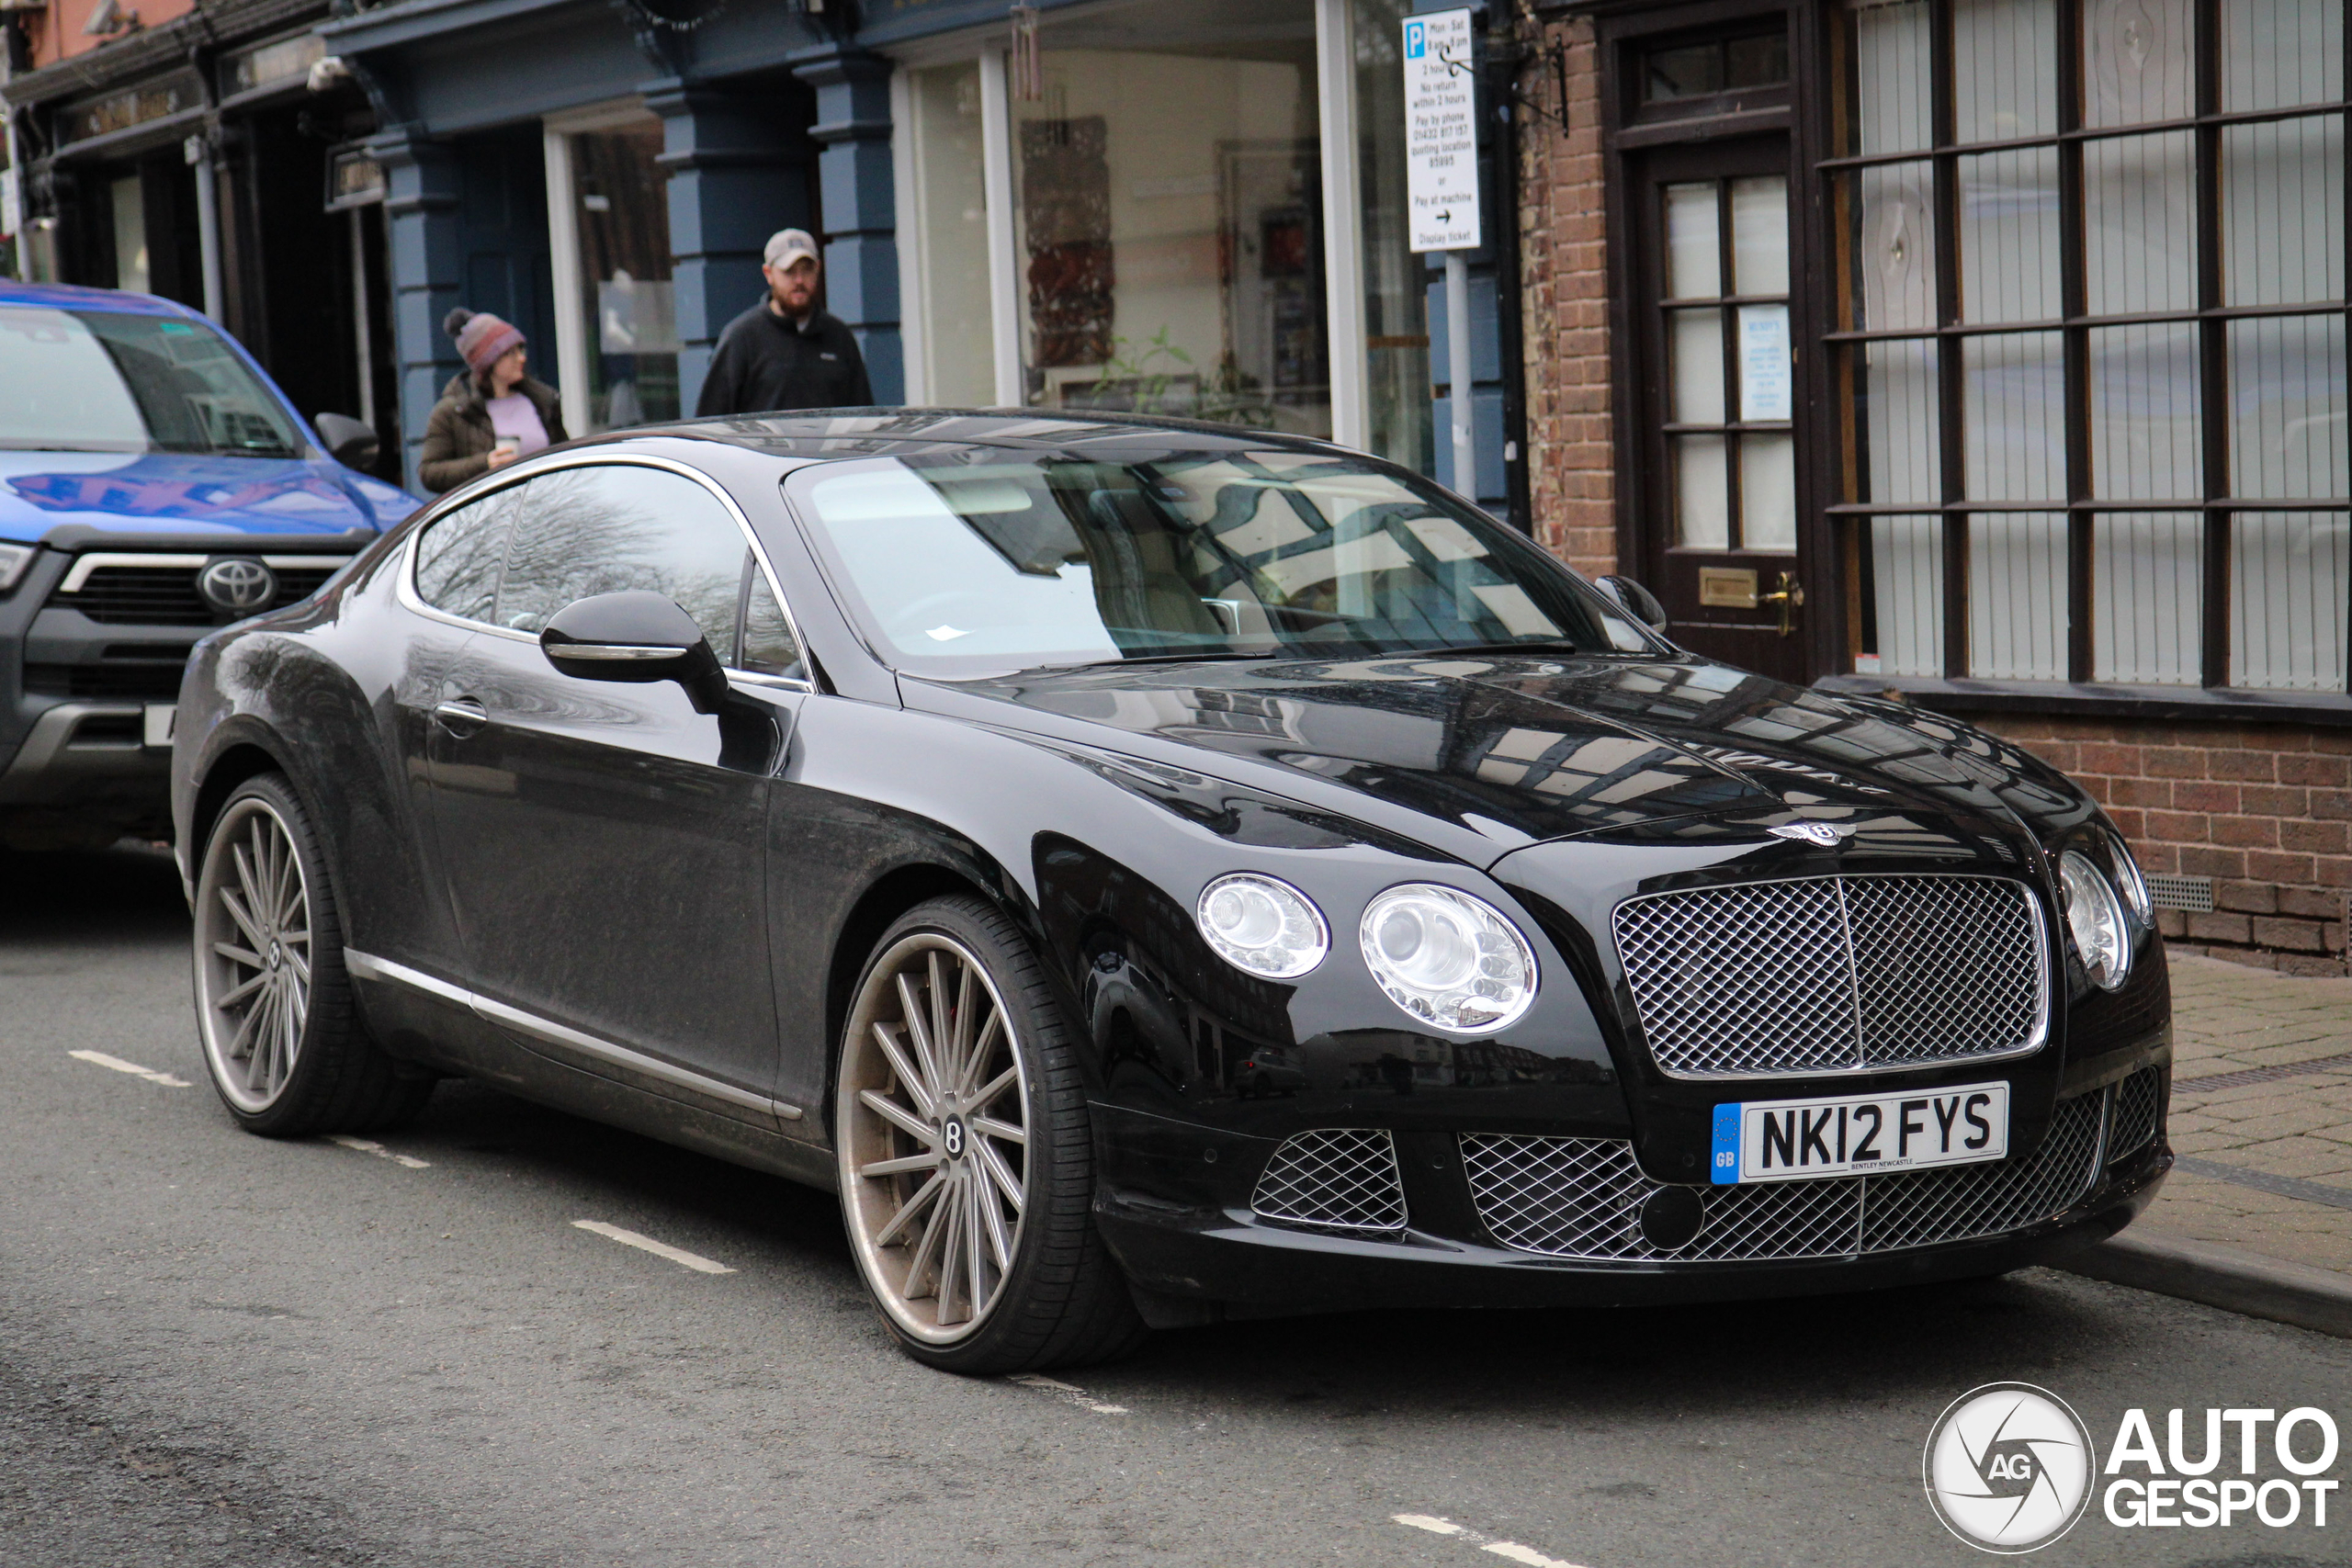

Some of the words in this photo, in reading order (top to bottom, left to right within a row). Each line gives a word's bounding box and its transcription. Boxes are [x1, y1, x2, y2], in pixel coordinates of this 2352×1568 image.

[1430, 23, 1445, 33] Mon
[1452, 18, 1464, 30] Sat
[1409, 25, 1423, 57] P
[1435, 39, 1444, 50] am
[1456, 37, 1468, 47] pm
[1423, 64, 1428, 75] 2
[1420, 83, 1430, 93] No
[1433, 81, 1456, 91] return
[1413, 96, 1435, 108] within
[1438, 95, 1442, 106] 2
[1444, 94, 1466, 104] hours
[1416, 115, 1429, 127] Pay
[1430, 113, 1440, 126] by
[1442, 112, 1464, 124] phone
[1411, 143, 1439, 157] quoting
[1441, 140, 1472, 152] location
[1438, 176, 1446, 186] or
[1415, 195, 1428, 208] Pay
[1430, 193, 1439, 205] at
[1441, 192, 1472, 204] machine
[1419, 232, 1446, 244] Display
[1449, 230, 1471, 242] ticket
[945, 1122, 961, 1154] B
[1761, 1103, 1883, 1168] NK12
[1898, 1093, 1991, 1157] FYS
[1715, 1151, 1735, 1168] GB
[1851, 1161, 1878, 1170] BENTLEY
[1879, 1158, 1914, 1168] NEWCASTLE
